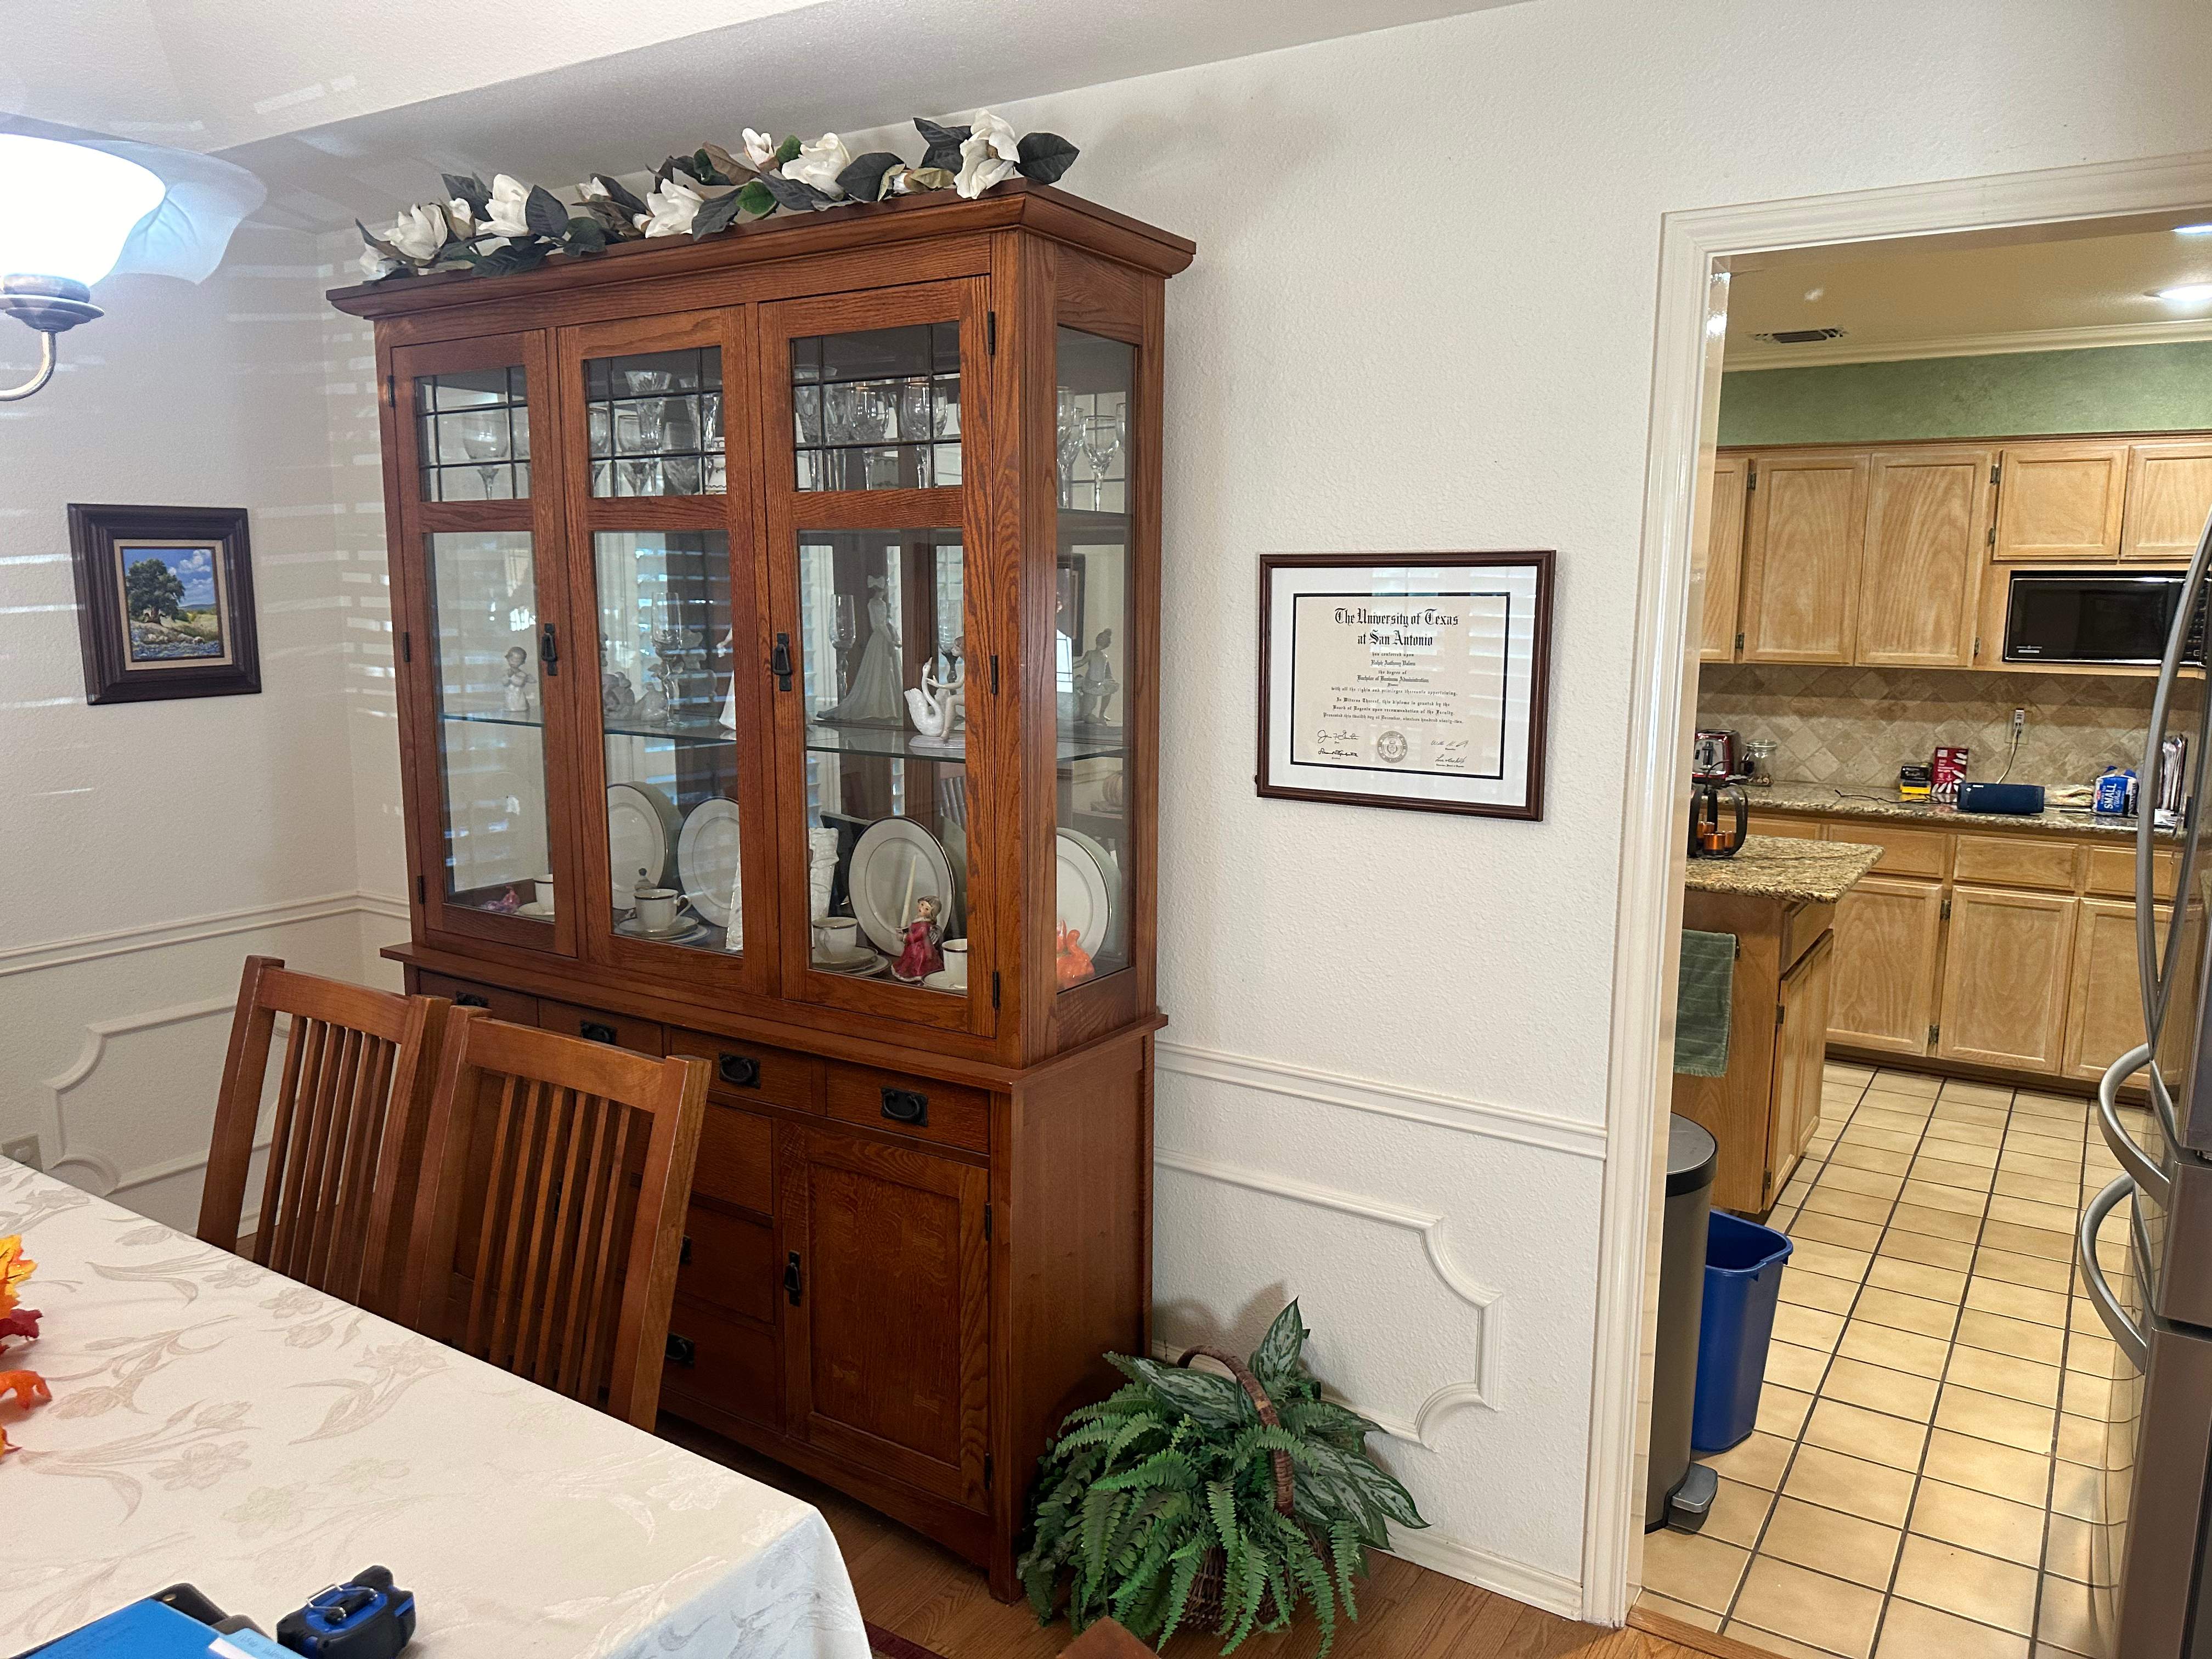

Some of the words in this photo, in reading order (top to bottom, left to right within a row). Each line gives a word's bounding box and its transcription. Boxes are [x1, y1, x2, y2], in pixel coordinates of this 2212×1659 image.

[1335, 608, 1355, 625] The
[1357, 608, 1408, 628] University
[1411, 612, 1422, 625] of
[1424, 608, 1459, 626] Texas
[1357, 634, 1366, 645] at
[1369, 629, 1390, 645] San
[1392, 630, 1433, 646] Antonio
[2104, 783, 2117, 809] SMALL
